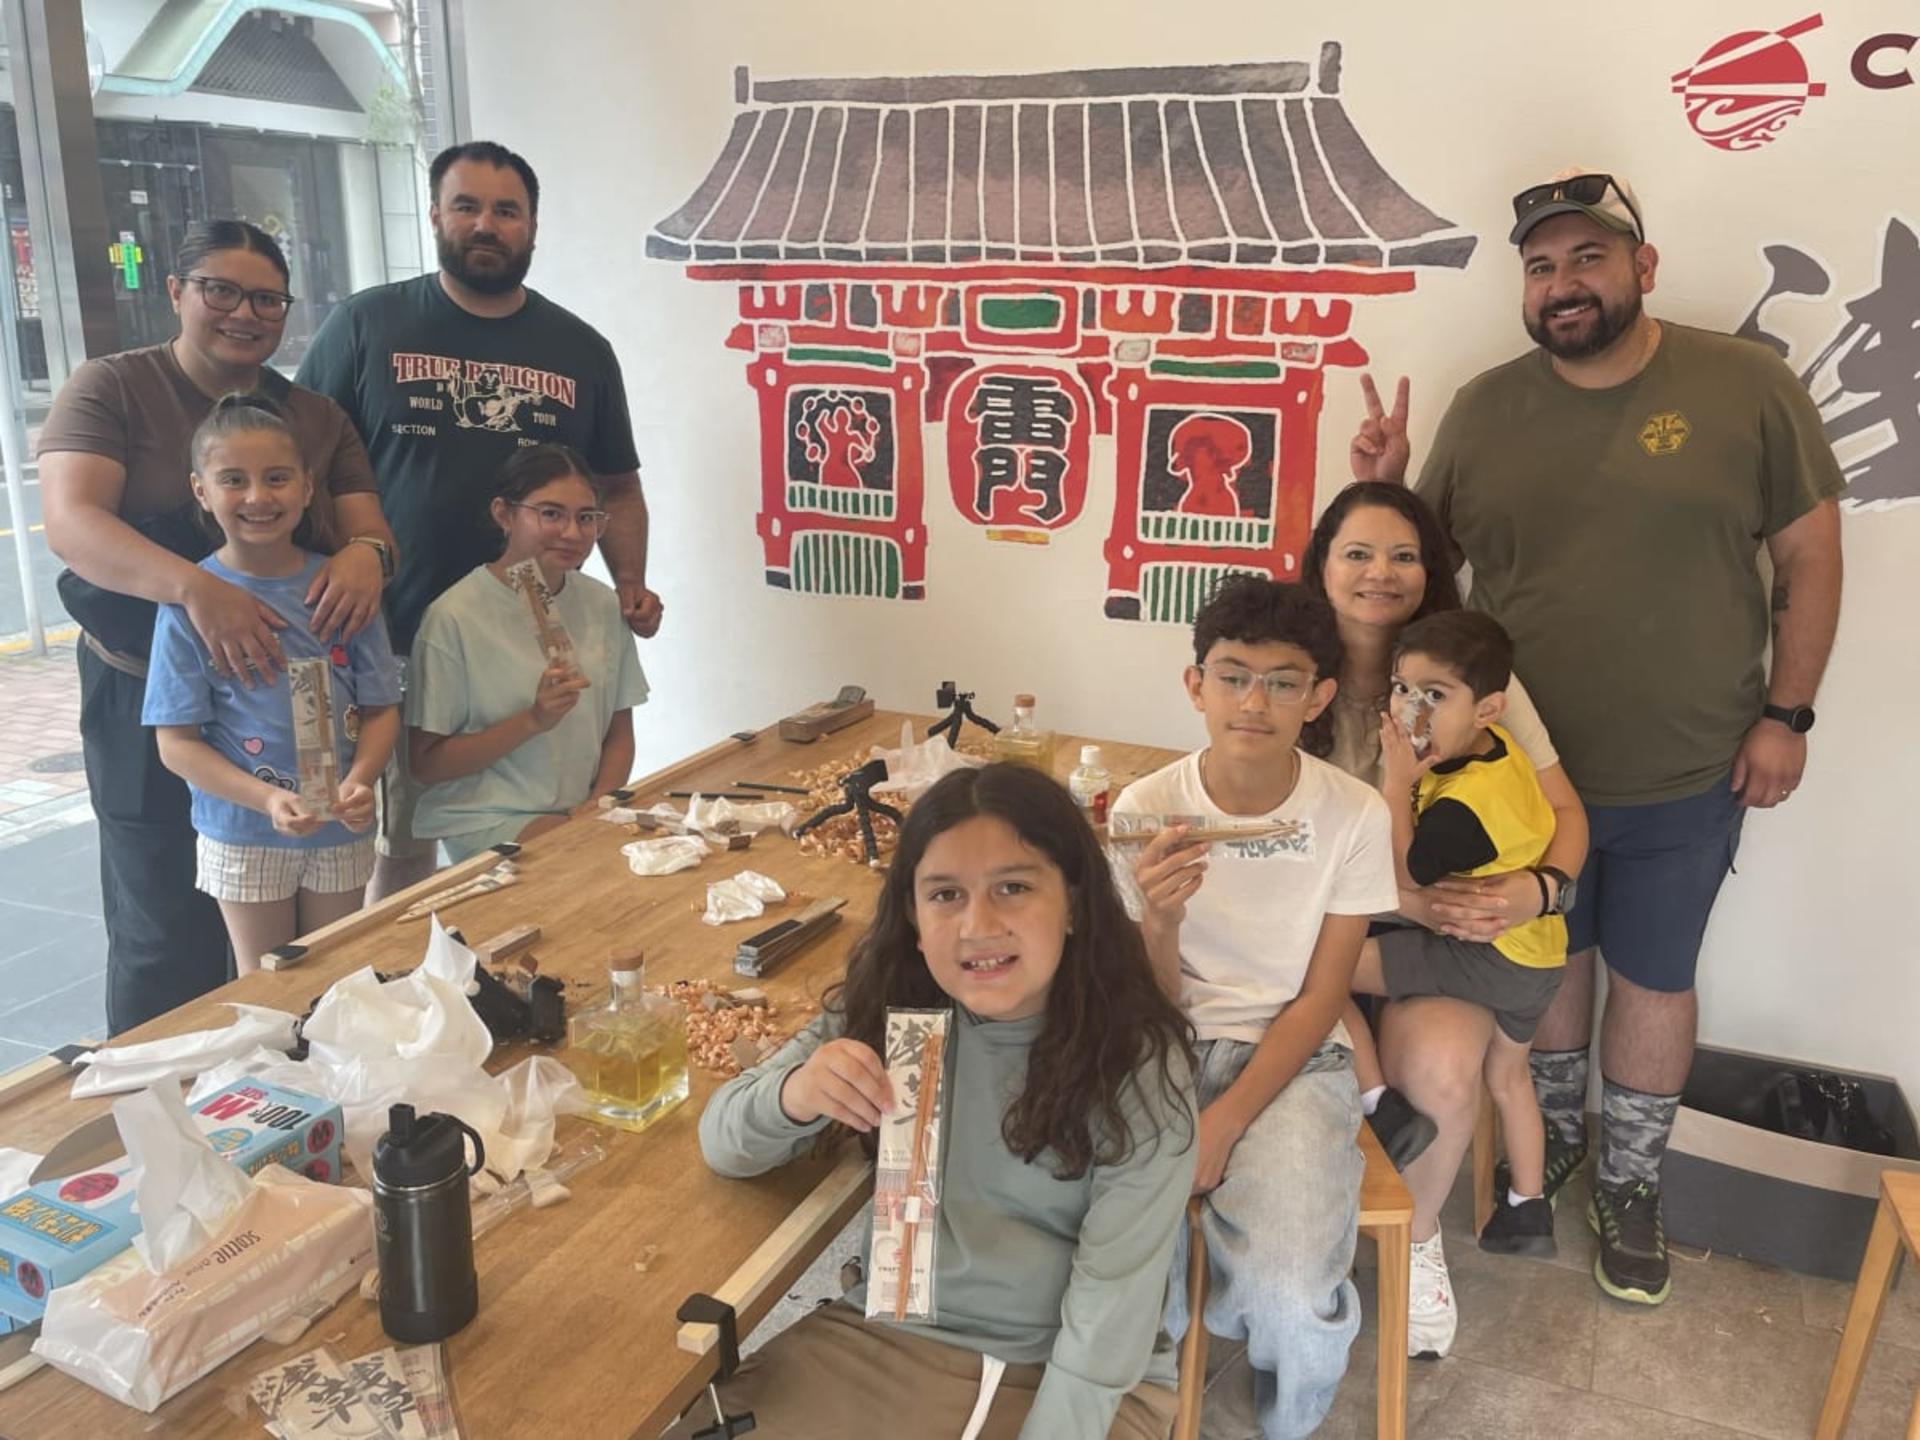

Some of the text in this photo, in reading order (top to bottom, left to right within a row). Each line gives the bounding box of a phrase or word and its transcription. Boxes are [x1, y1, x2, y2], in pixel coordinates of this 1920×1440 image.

[393, 353, 576, 409] TRUE RLIGION
[409, 396, 557, 427] WORLD TOUR
[391, 424, 437, 437] SECTION
[967, 375, 1075, 521] 雷門
[199, 1093, 258, 1122] M
